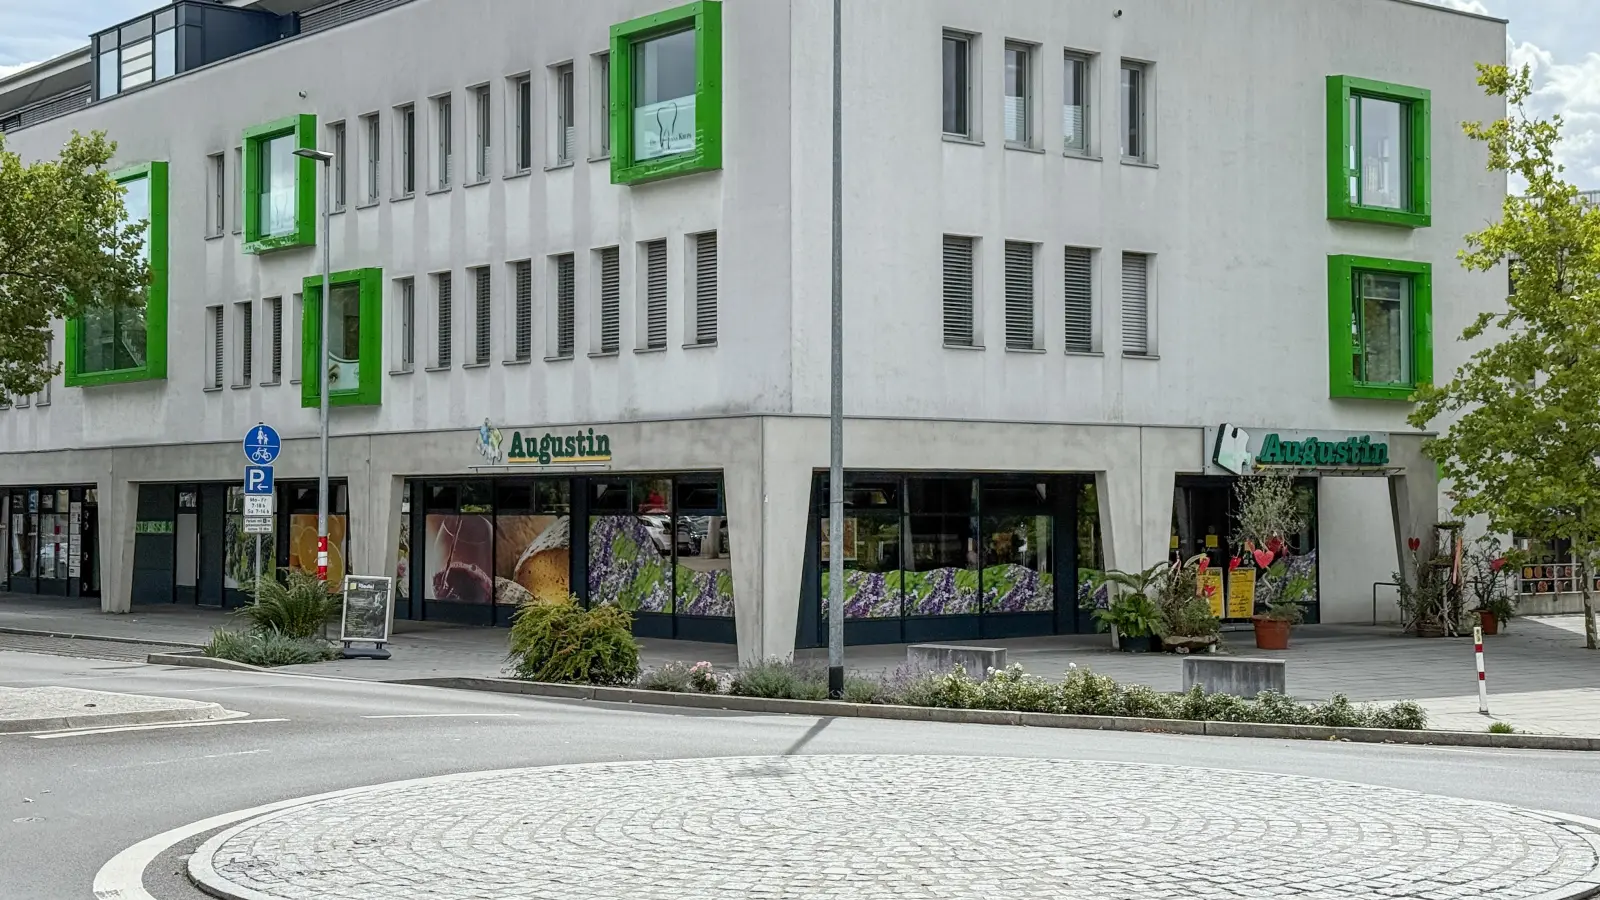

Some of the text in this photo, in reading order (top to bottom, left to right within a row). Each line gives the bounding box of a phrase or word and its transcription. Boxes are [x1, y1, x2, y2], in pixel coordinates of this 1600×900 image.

[508, 428, 611, 464] Augustin
[1256, 434, 1389, 466] Augustin
[249, 469, 265, 490] P
